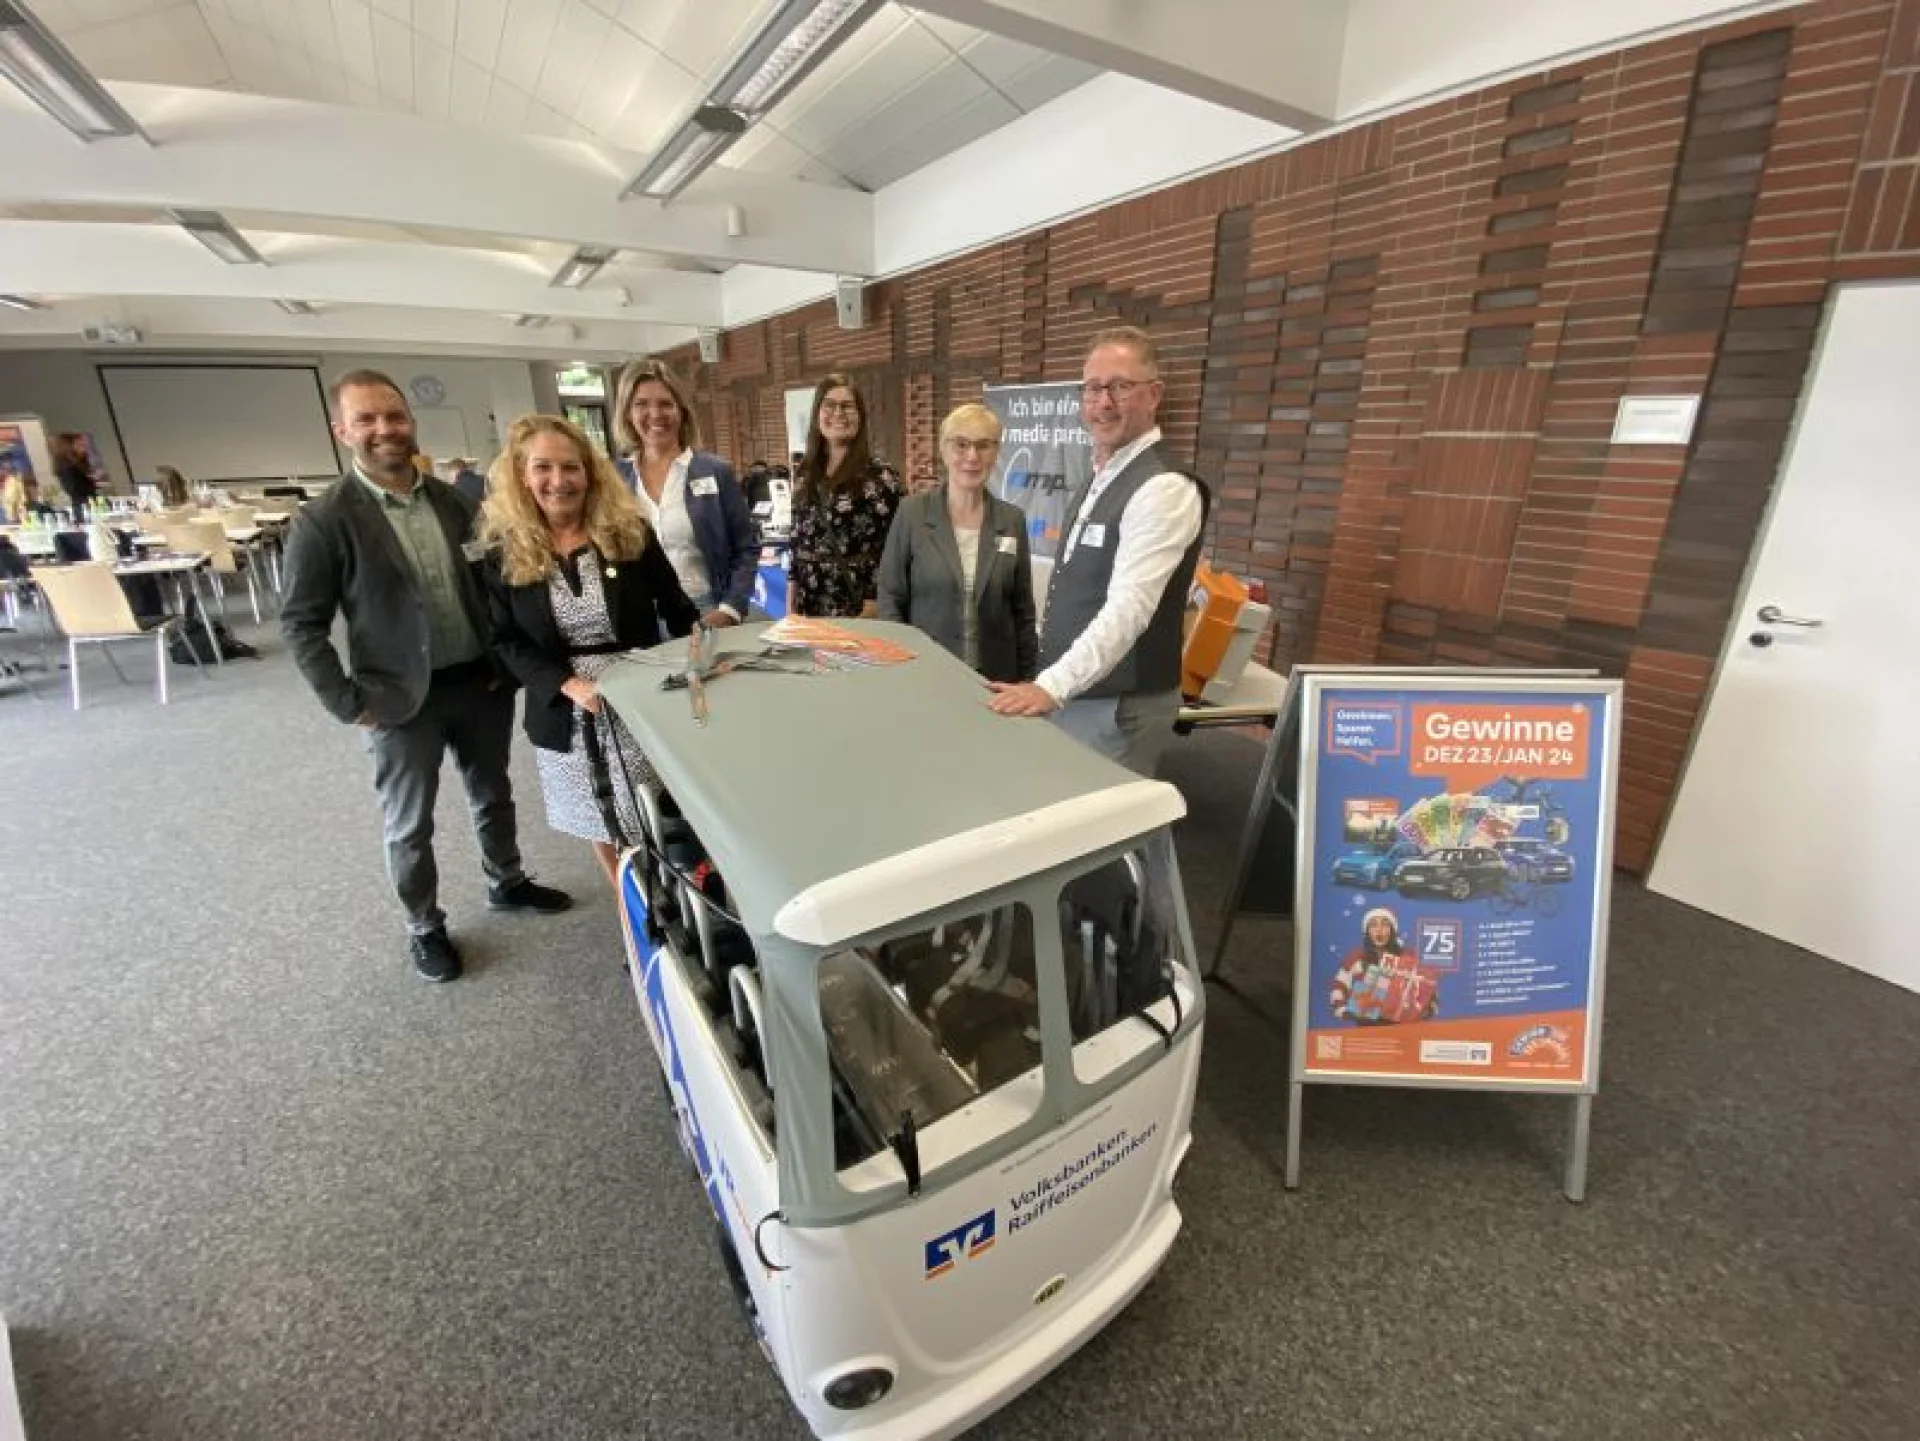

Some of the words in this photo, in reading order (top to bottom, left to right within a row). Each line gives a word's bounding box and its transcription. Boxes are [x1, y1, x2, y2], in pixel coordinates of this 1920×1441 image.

[1008, 396, 1029, 418] Ich
[1031, 395, 1055, 416] bin
[1425, 711, 1574, 743] Gewinne
[1424, 745, 1463, 764] DEZ
[1549, 748, 1574, 766] 24
[1423, 931, 1455, 953] 75
[1008, 1120, 1158, 1236] Raiffeisenbanken
[1010, 1128, 1129, 1212] Volksbanken
